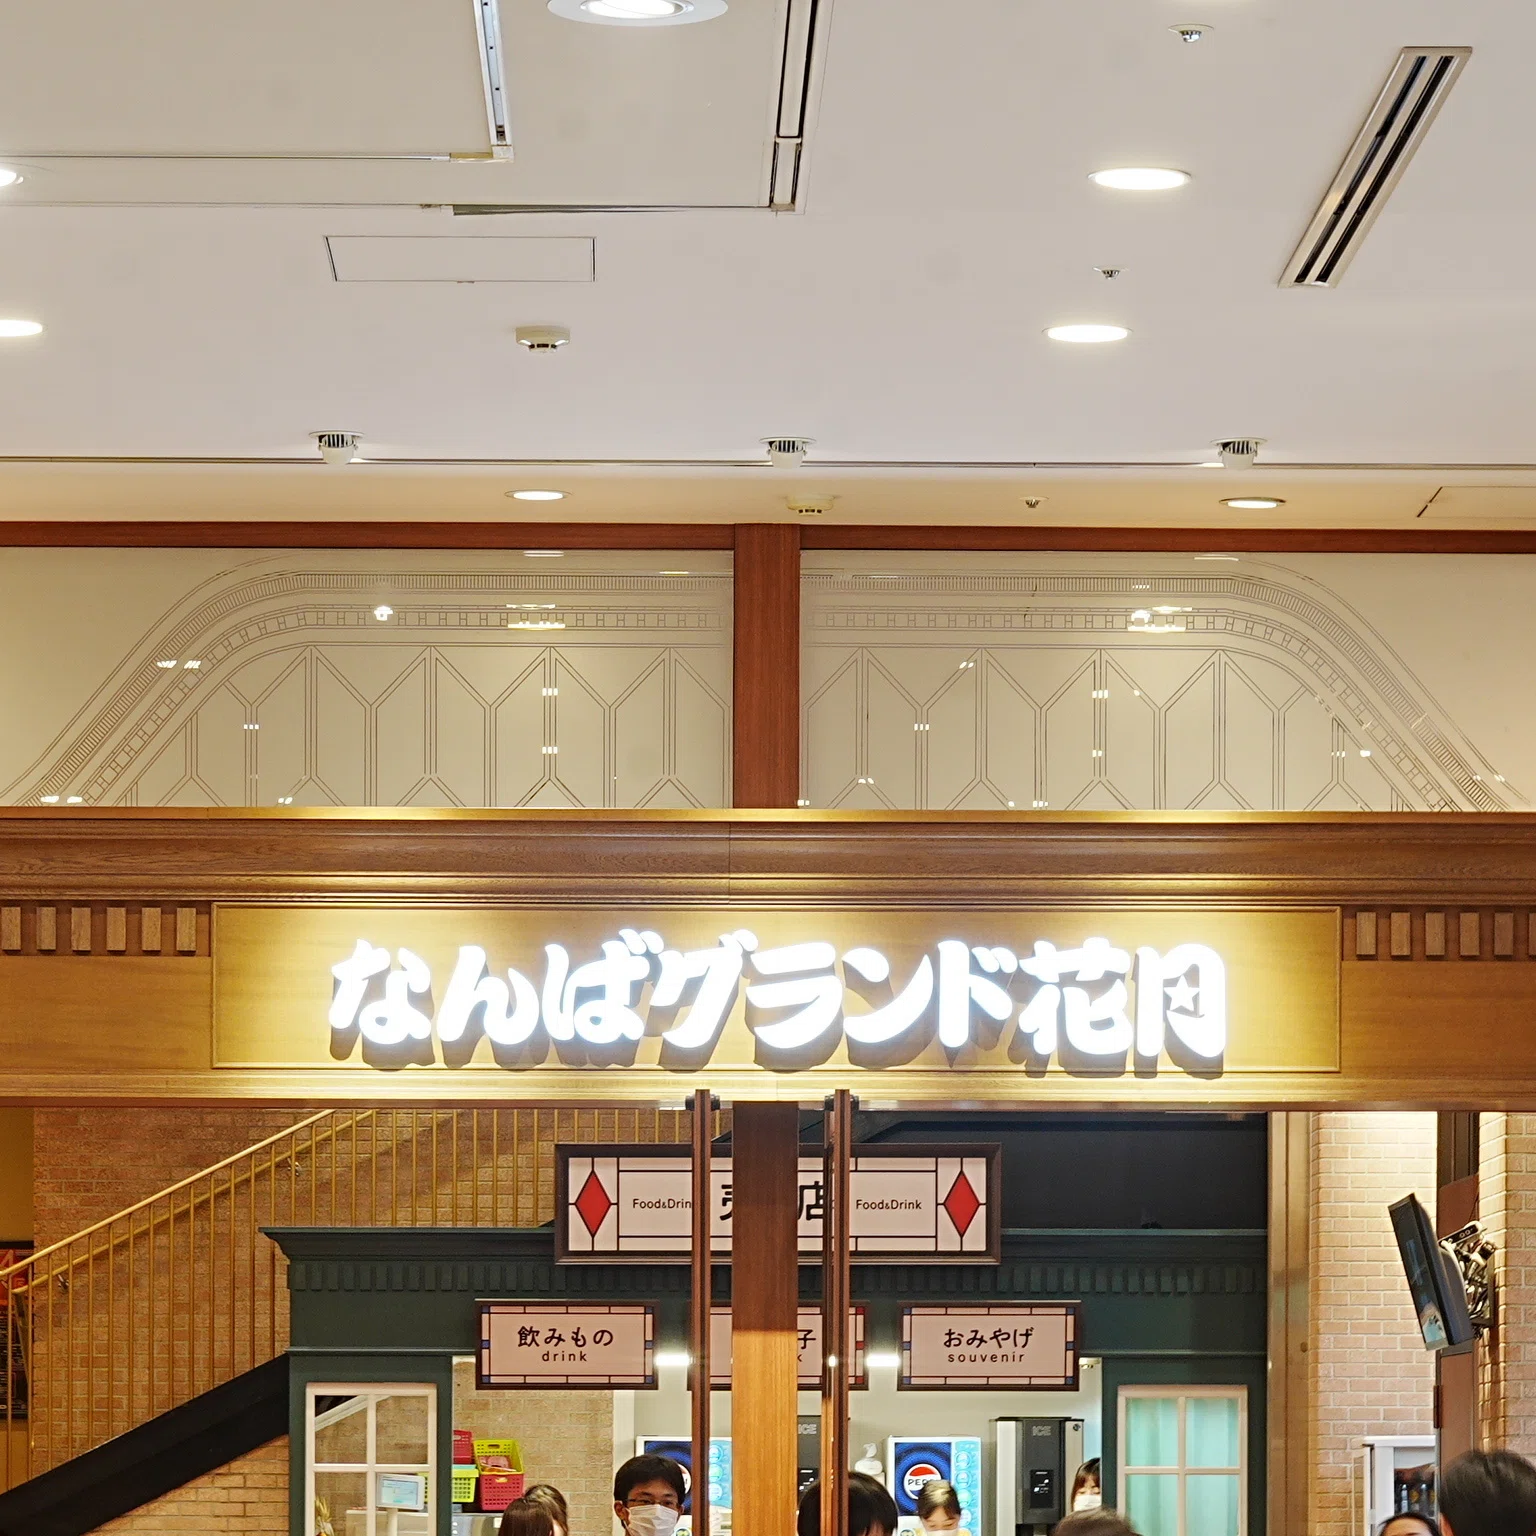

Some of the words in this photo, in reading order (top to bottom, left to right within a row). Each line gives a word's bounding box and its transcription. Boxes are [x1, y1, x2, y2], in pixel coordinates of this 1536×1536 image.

[328, 928, 1226, 1058] なんばグランド花月
[632, 1198, 692, 1209] Food&Drin
[855, 1199, 922, 1210] Food&Drink
[517, 1325, 614, 1348] 飲みもの
[943, 1326, 1035, 1349] おみやげ
[541, 1350, 588, 1362] drink
[947, 1351, 1025, 1363] souvenir
[1032, 1425, 1052, 1436] ICE
